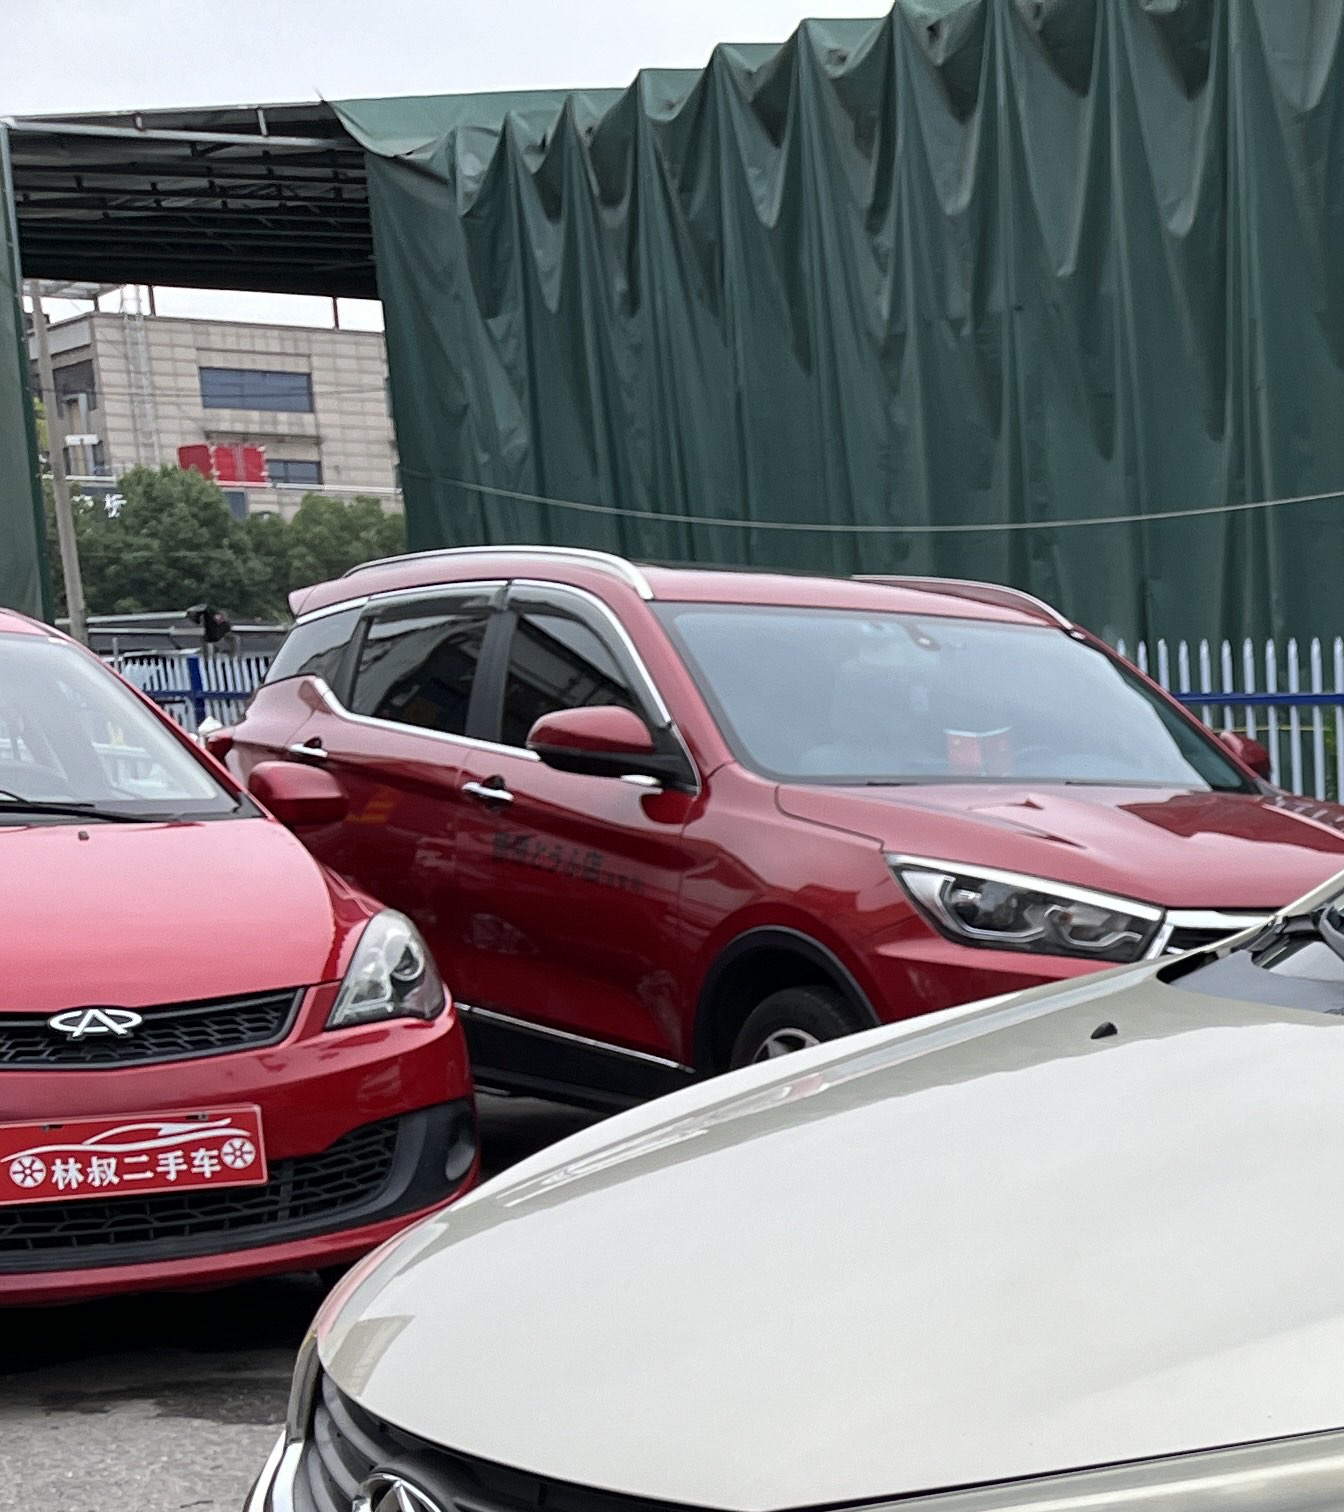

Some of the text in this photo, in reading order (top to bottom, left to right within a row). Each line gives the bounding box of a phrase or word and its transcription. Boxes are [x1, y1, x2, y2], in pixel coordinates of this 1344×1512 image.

[51, 1148, 222, 1190] 林叔二手车
